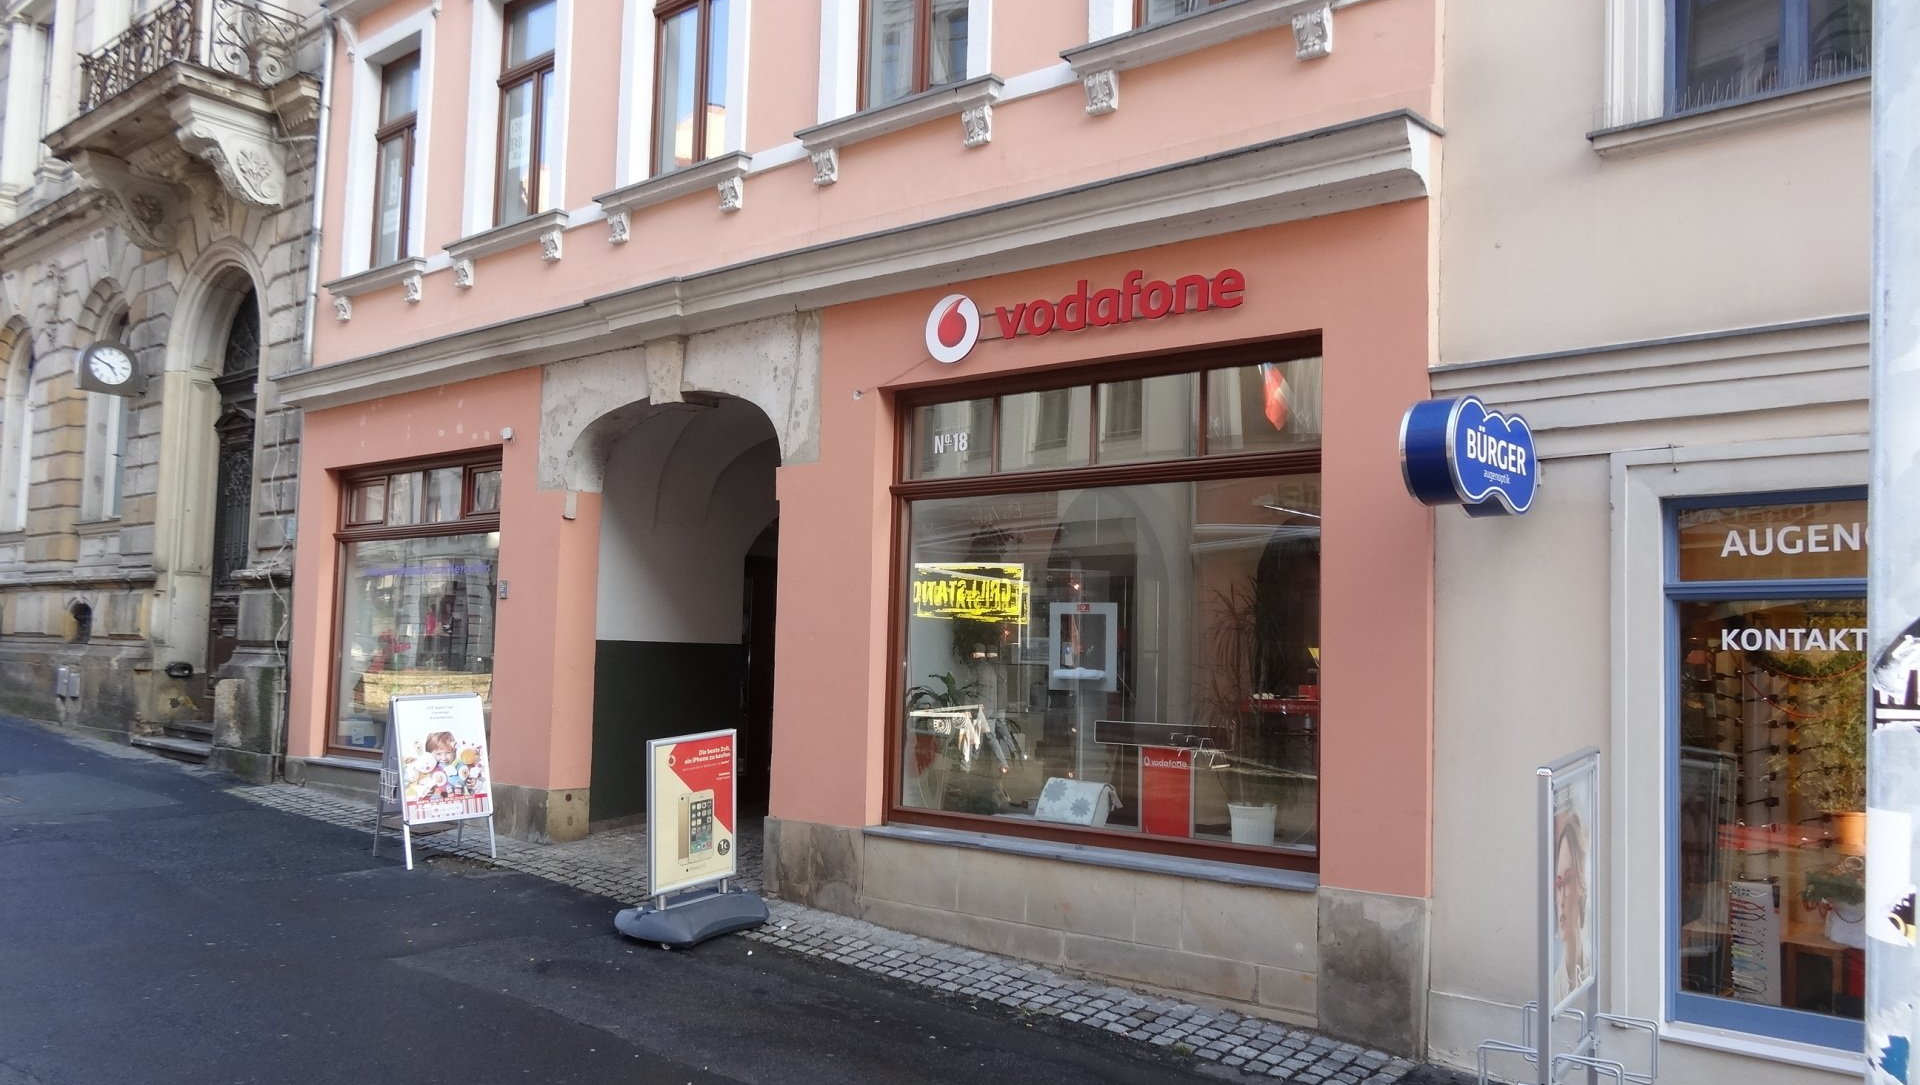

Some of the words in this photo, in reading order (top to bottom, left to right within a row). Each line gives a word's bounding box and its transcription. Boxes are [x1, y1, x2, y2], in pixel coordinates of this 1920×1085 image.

[995, 269, 1246, 340] vodafone
[1466, 425, 1527, 477] BÜRGER
[1483, 469, 1511, 485] augenoptik
[1720, 522, 1869, 558] AUGEN
[1721, 628, 1869, 652] KONTAKT
[1151, 759, 1188, 768] vodafone
